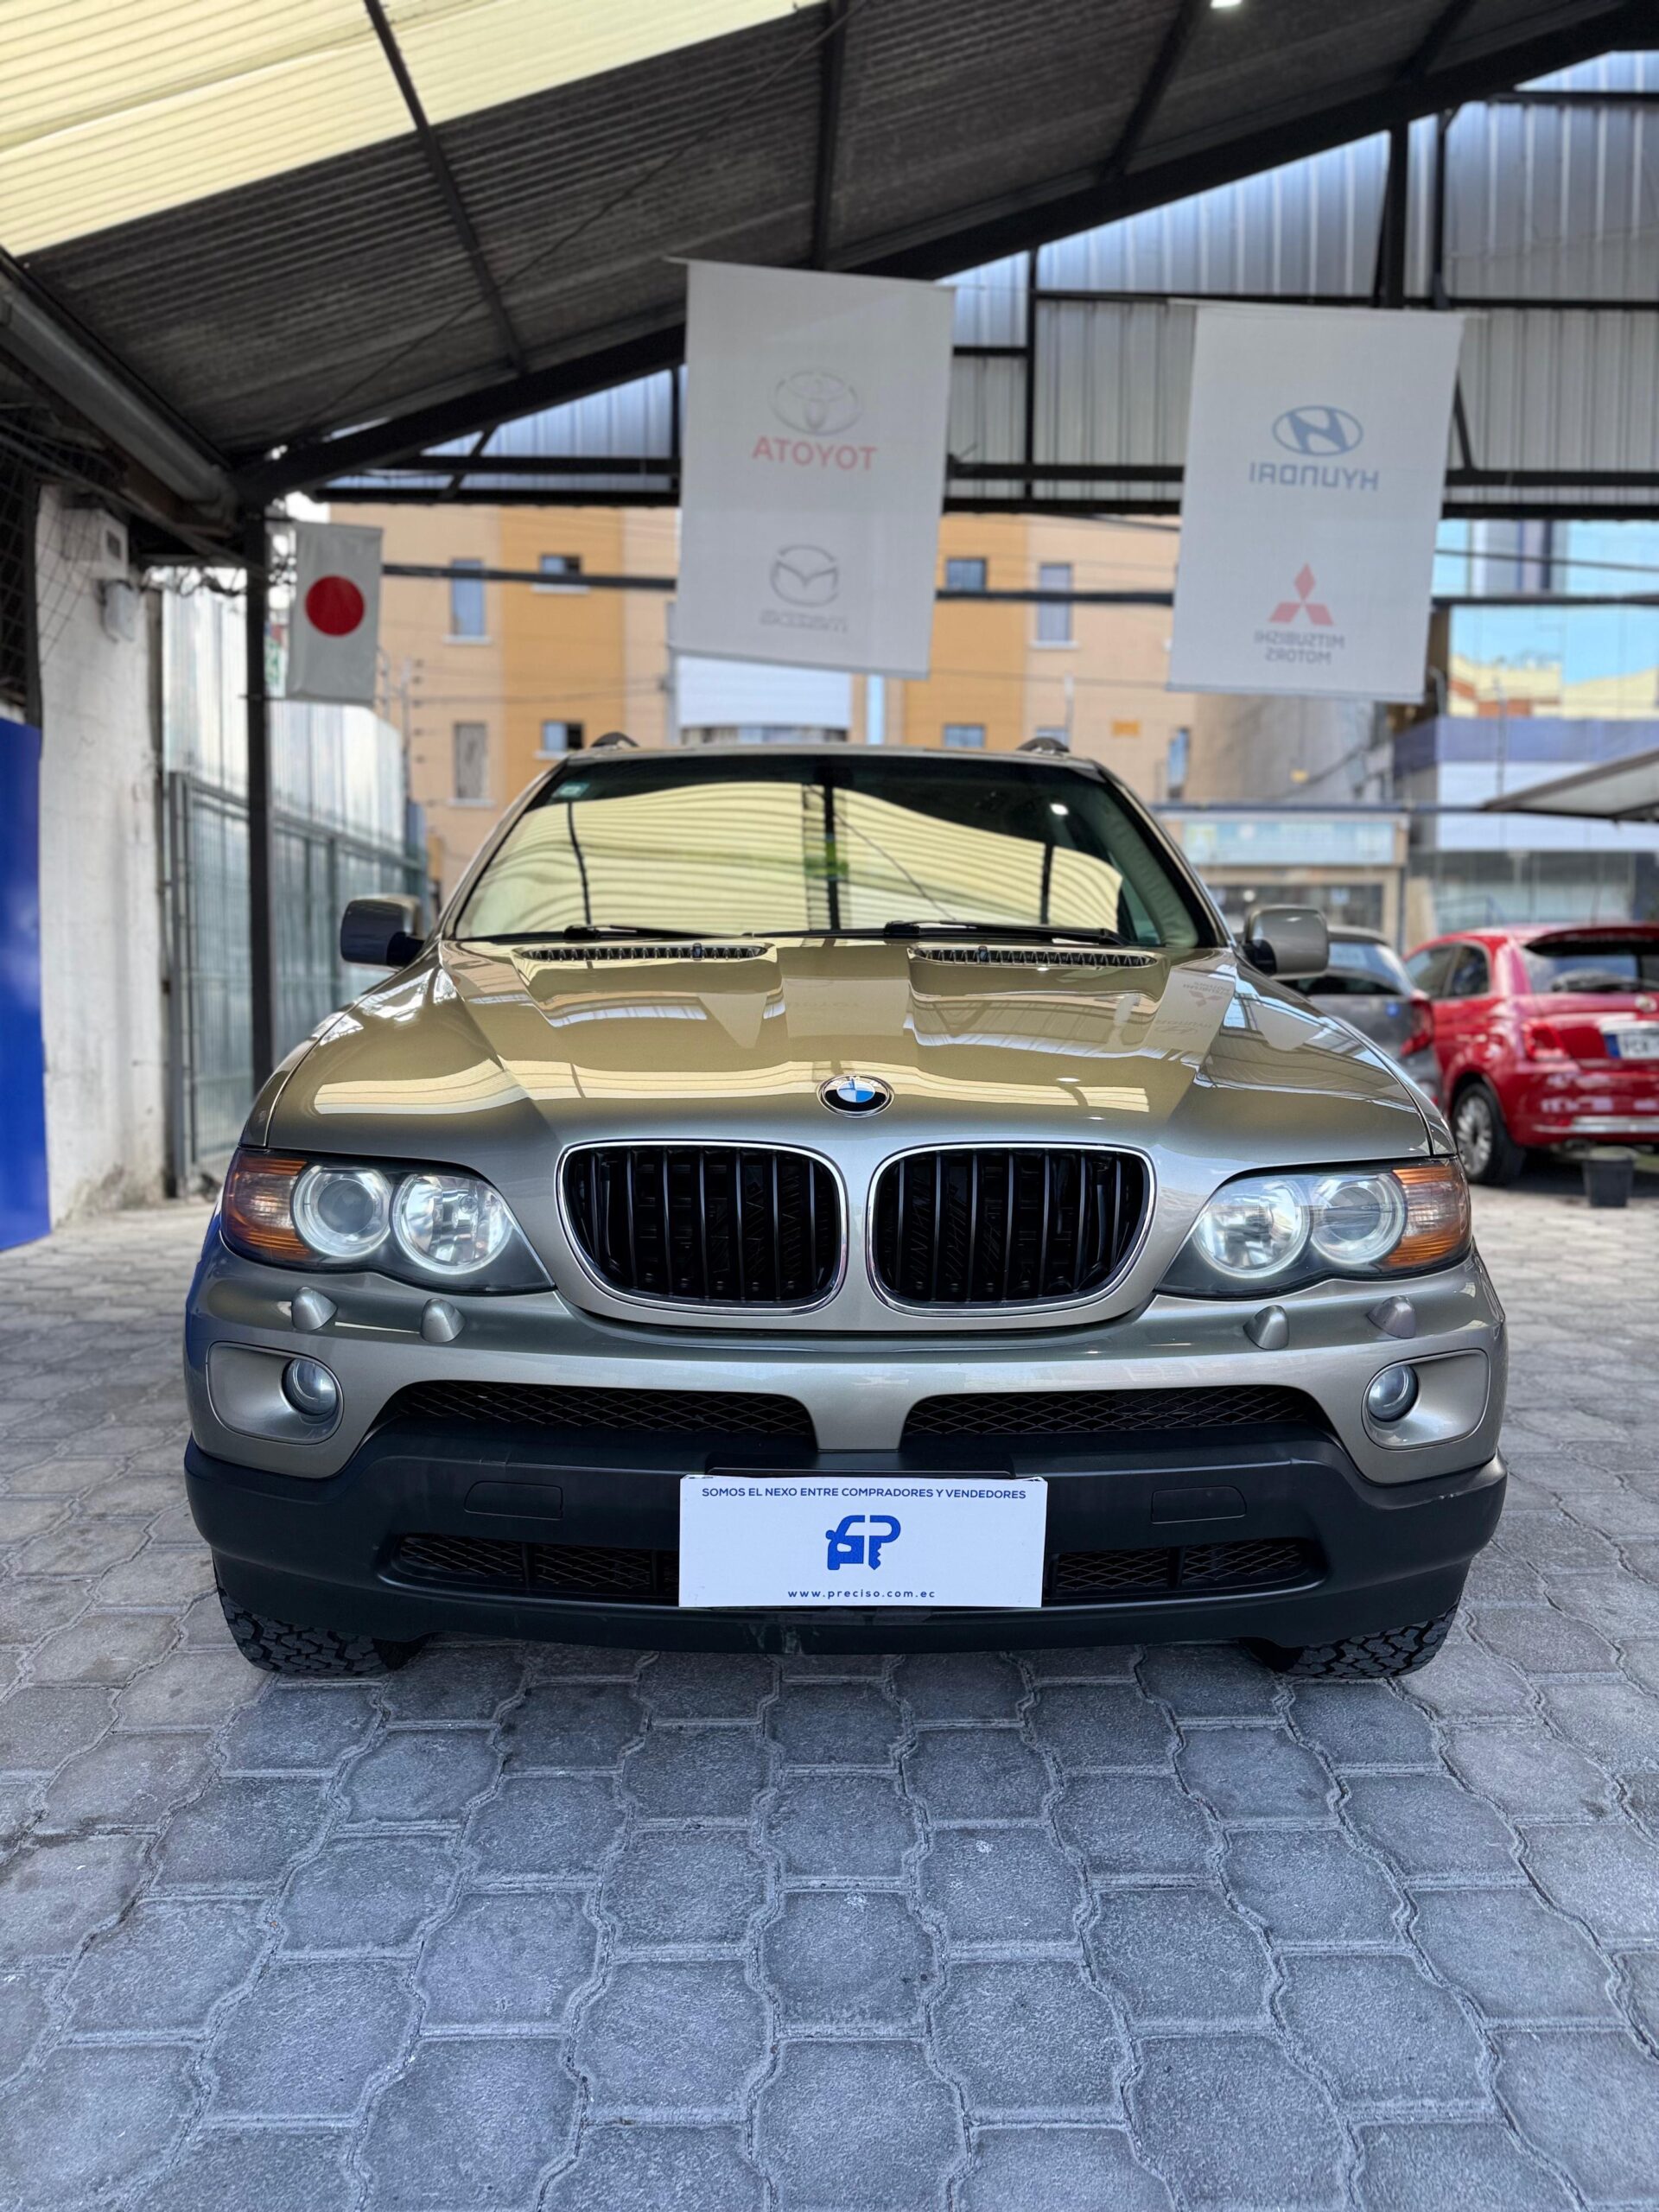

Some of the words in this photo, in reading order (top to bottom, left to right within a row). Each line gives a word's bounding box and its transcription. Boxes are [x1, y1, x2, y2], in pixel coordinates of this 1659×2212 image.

[702, 1488, 746, 1497] SOMOS
[748, 1488, 763, 1497] EL
[765, 1488, 798, 1497] NEXO
[800, 1488, 839, 1497] ENTRE
[842, 1488, 933, 1497] COMPRADORES
[933, 1489, 944, 1497] Y
[945, 1489, 1027, 1499] VENDEDORES
[788, 1589, 936, 1599] www.preciso.com.ec
